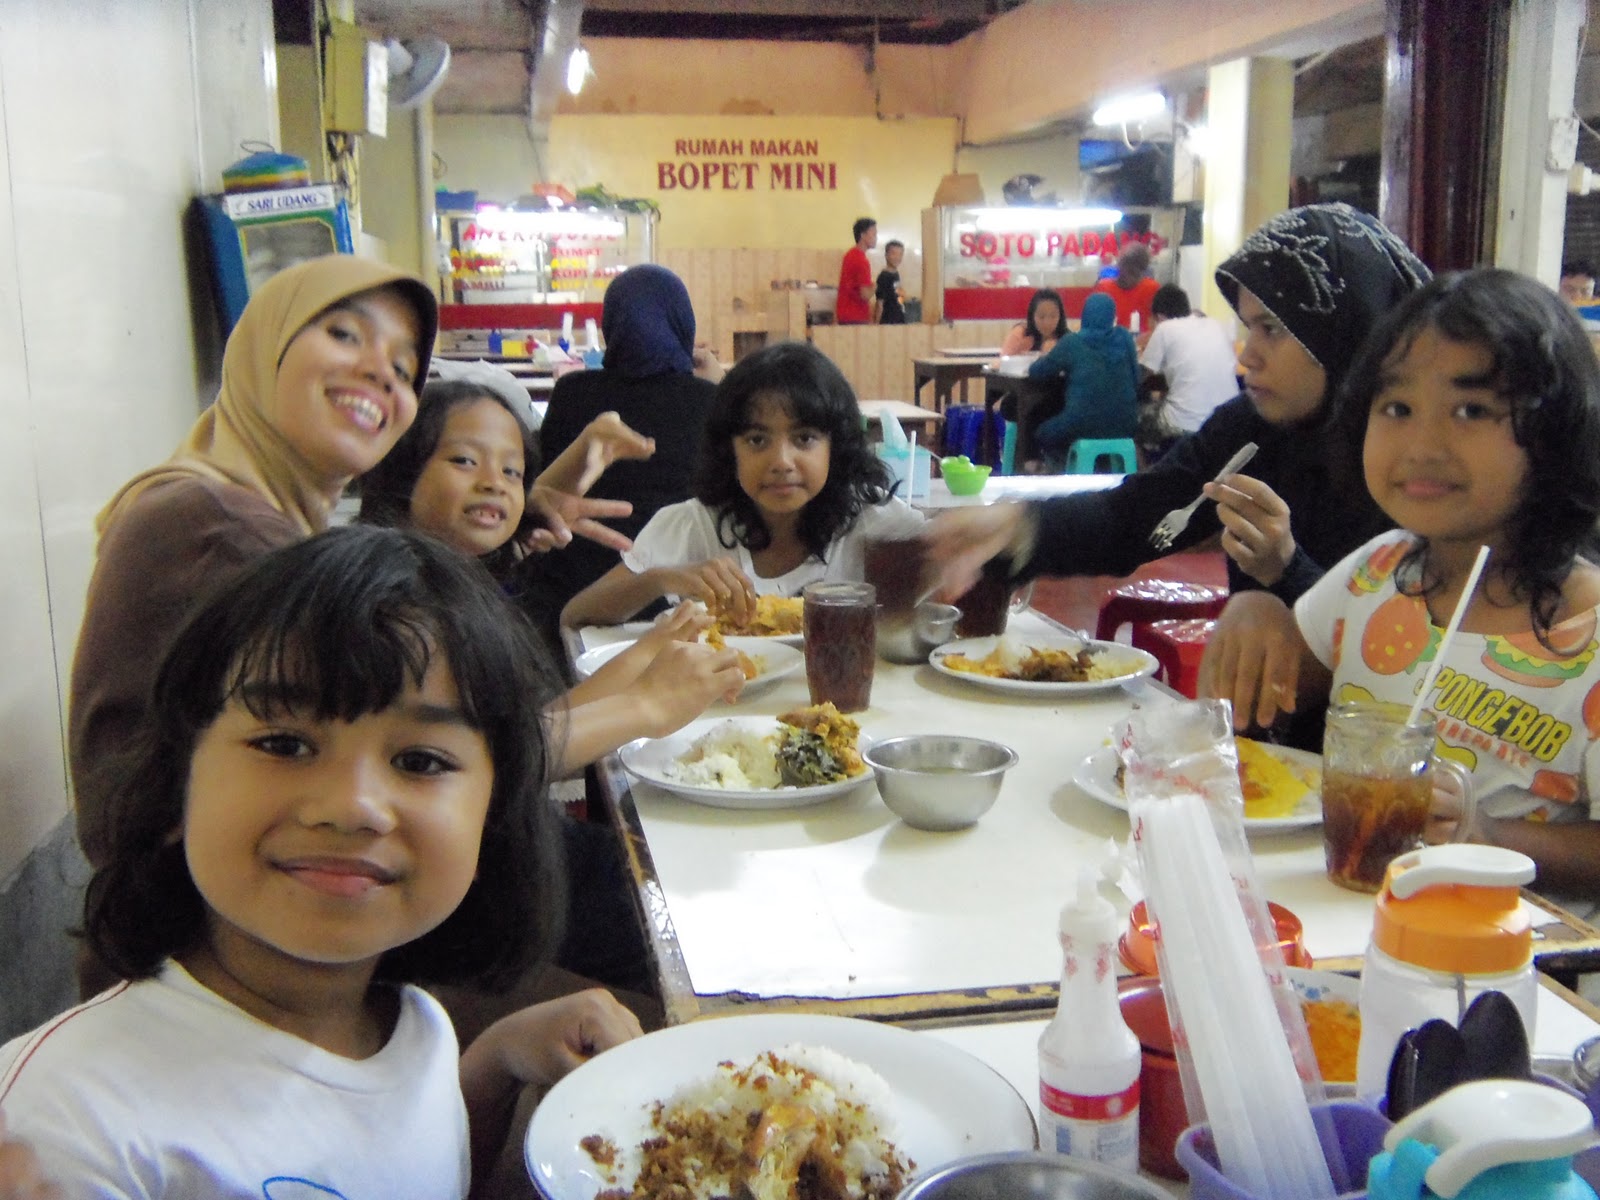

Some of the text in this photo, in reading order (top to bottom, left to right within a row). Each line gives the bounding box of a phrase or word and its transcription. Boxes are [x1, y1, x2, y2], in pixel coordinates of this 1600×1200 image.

[675, 139, 819, 156] RUMAH MAKAN
[657, 162, 838, 190] BOPET MINI
[247, 193, 317, 210] SARI UDANG
[959, 231, 1036, 258] SOTO
